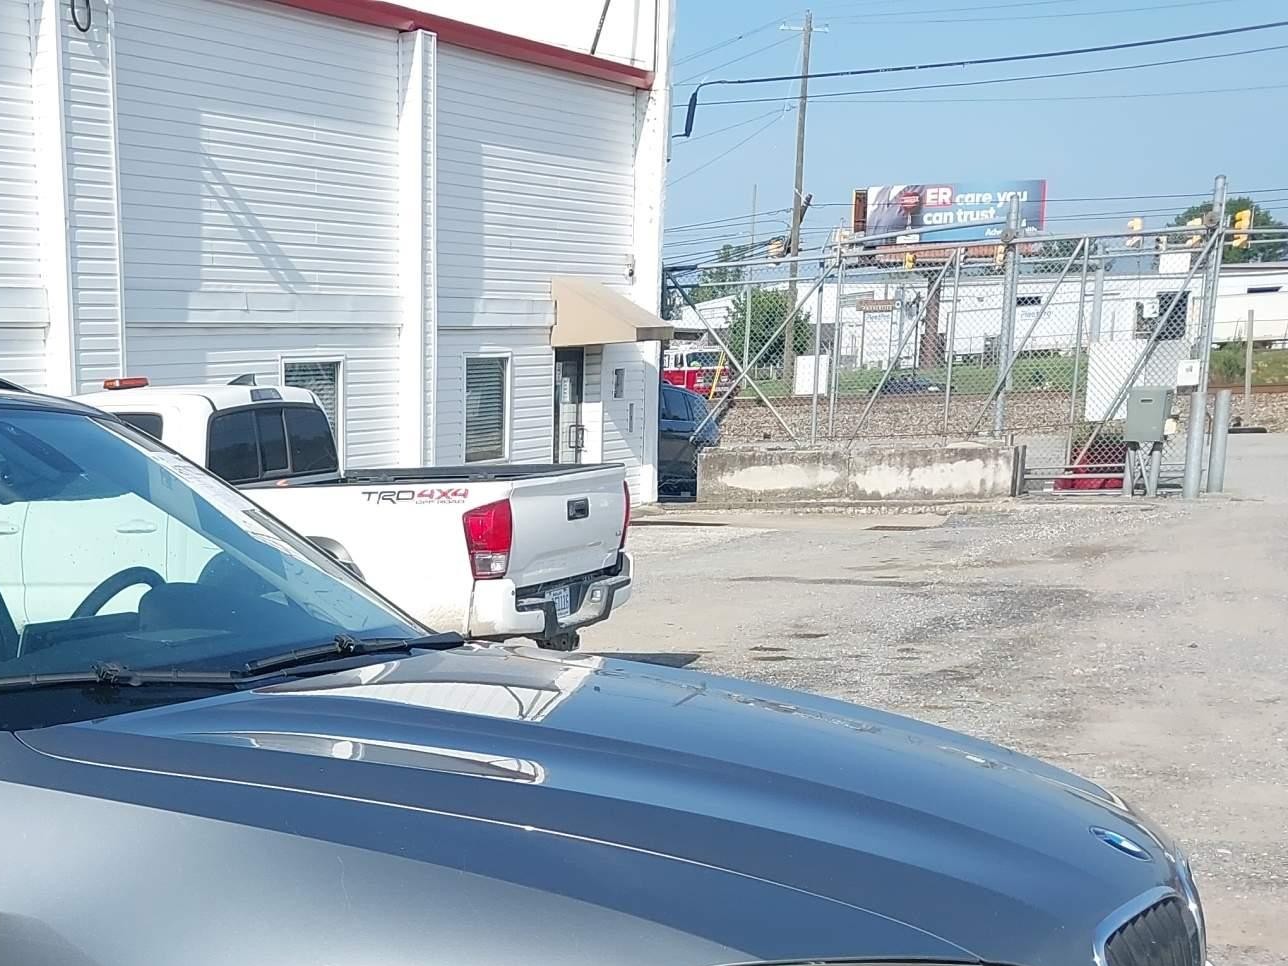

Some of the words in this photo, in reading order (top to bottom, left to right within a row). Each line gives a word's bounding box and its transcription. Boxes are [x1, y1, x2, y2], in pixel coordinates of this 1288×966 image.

[925, 187, 952, 206] ER
[956, 191, 992, 206] care
[996, 190, 1028, 208] you
[922, 212, 954, 225] can
[361, 489, 415, 505] TRD
